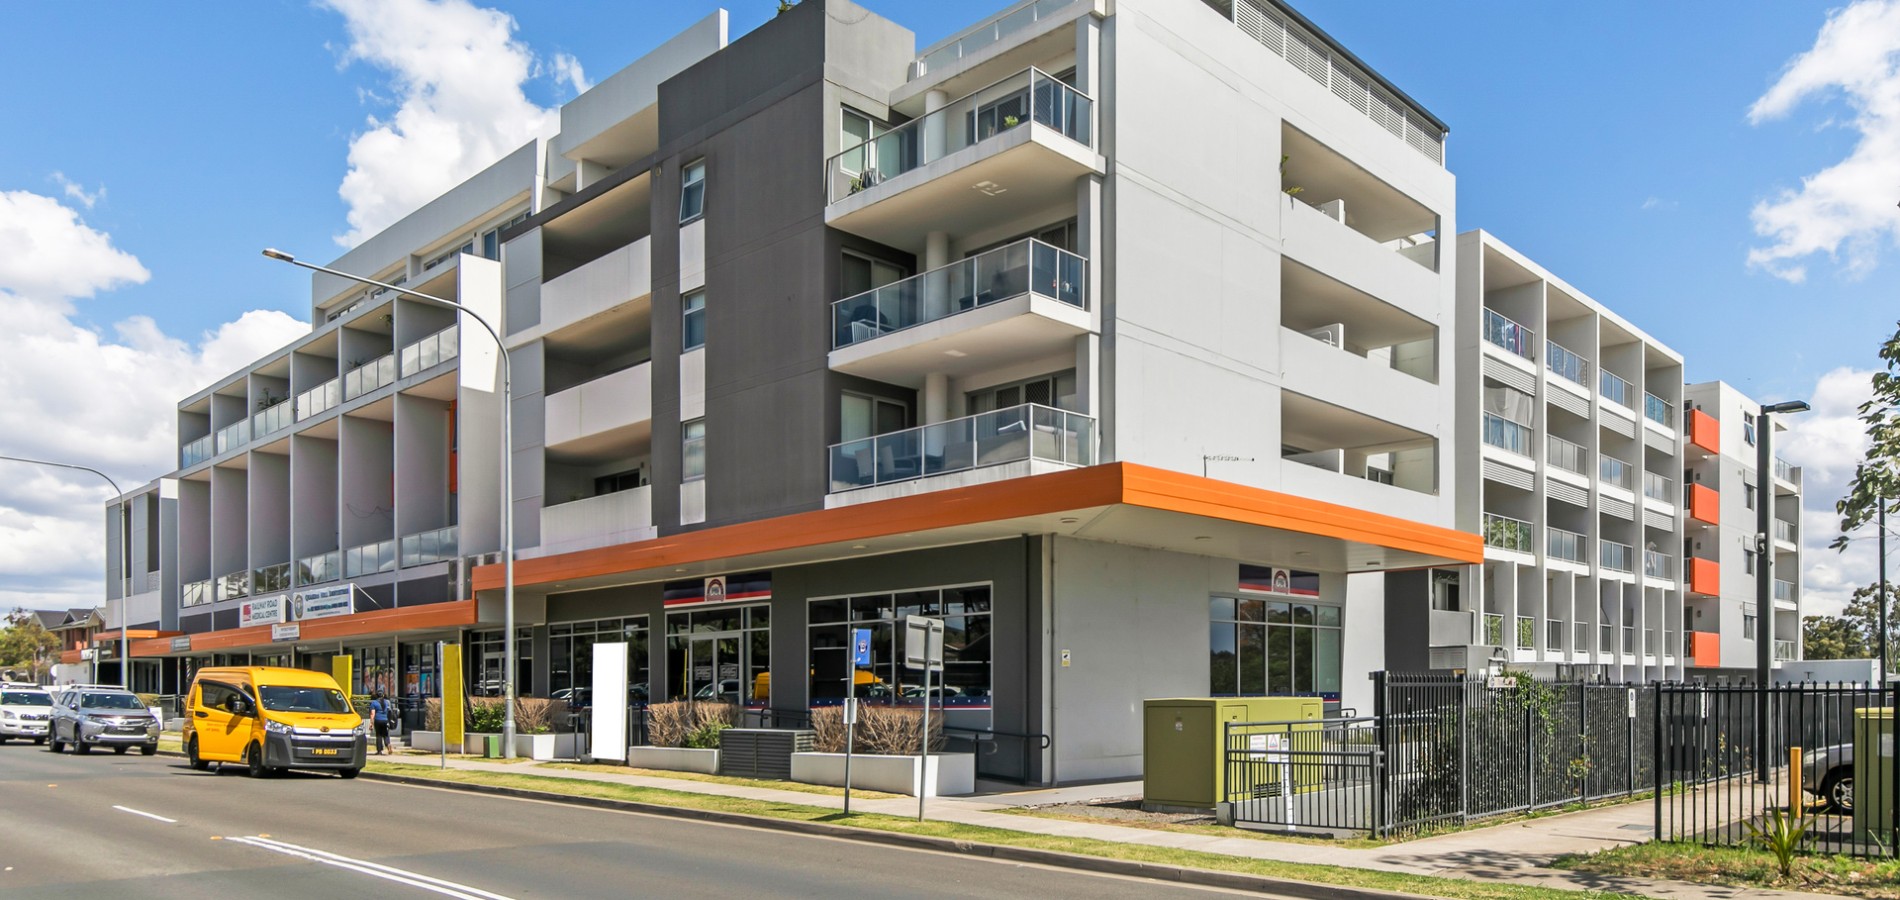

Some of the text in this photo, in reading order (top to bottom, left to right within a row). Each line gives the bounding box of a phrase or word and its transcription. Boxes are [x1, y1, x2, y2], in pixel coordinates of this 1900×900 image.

[252, 599, 277, 610] RAILWAY ROAD
[265, 609, 277, 617] CENTRE
